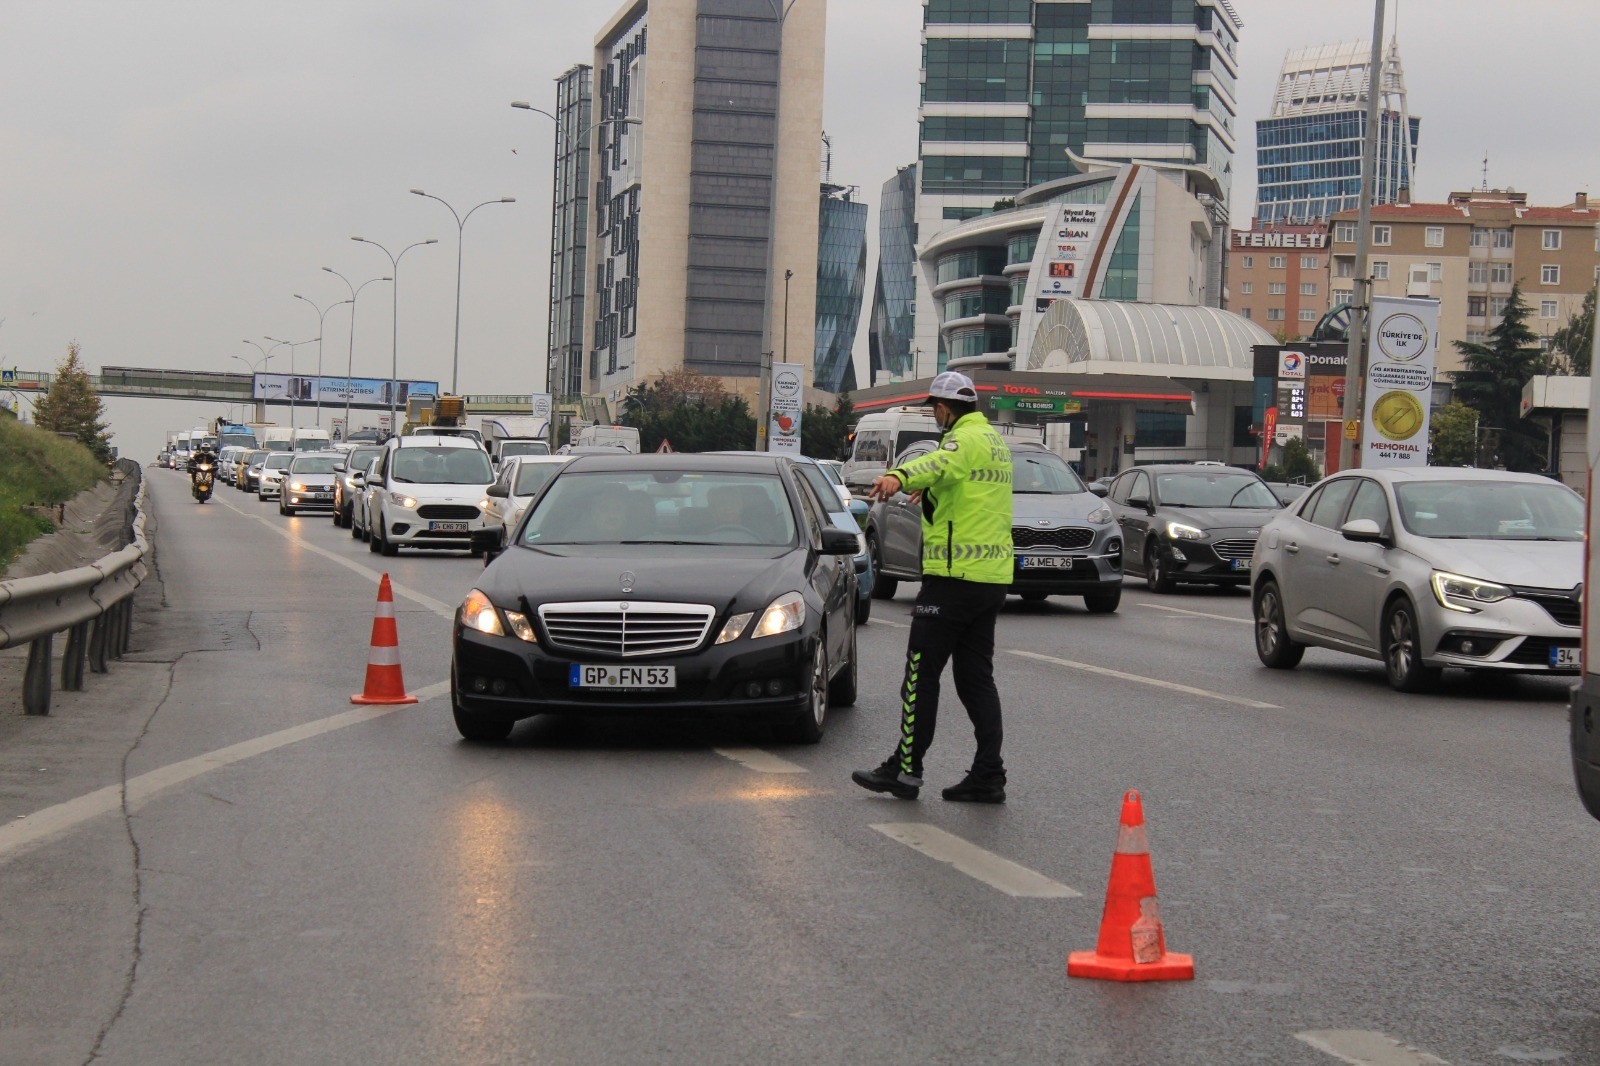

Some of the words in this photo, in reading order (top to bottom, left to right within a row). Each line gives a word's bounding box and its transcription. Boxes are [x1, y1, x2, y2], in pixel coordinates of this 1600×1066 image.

[1381, 330, 1422, 340] TÜRKİYE'DE
[1003, 384, 1041, 394] TOTAL
[1371, 442, 1419, 452] MEMORIAL
[1025, 558, 1034, 566] 34
[1038, 558, 1057, 566] MEL
[1060, 558, 1071, 567] 26
[1559, 650, 1573, 662] 34
[585, 668, 607, 684] GP
[620, 668, 642, 684] FN
[647, 668, 669, 685] 53
